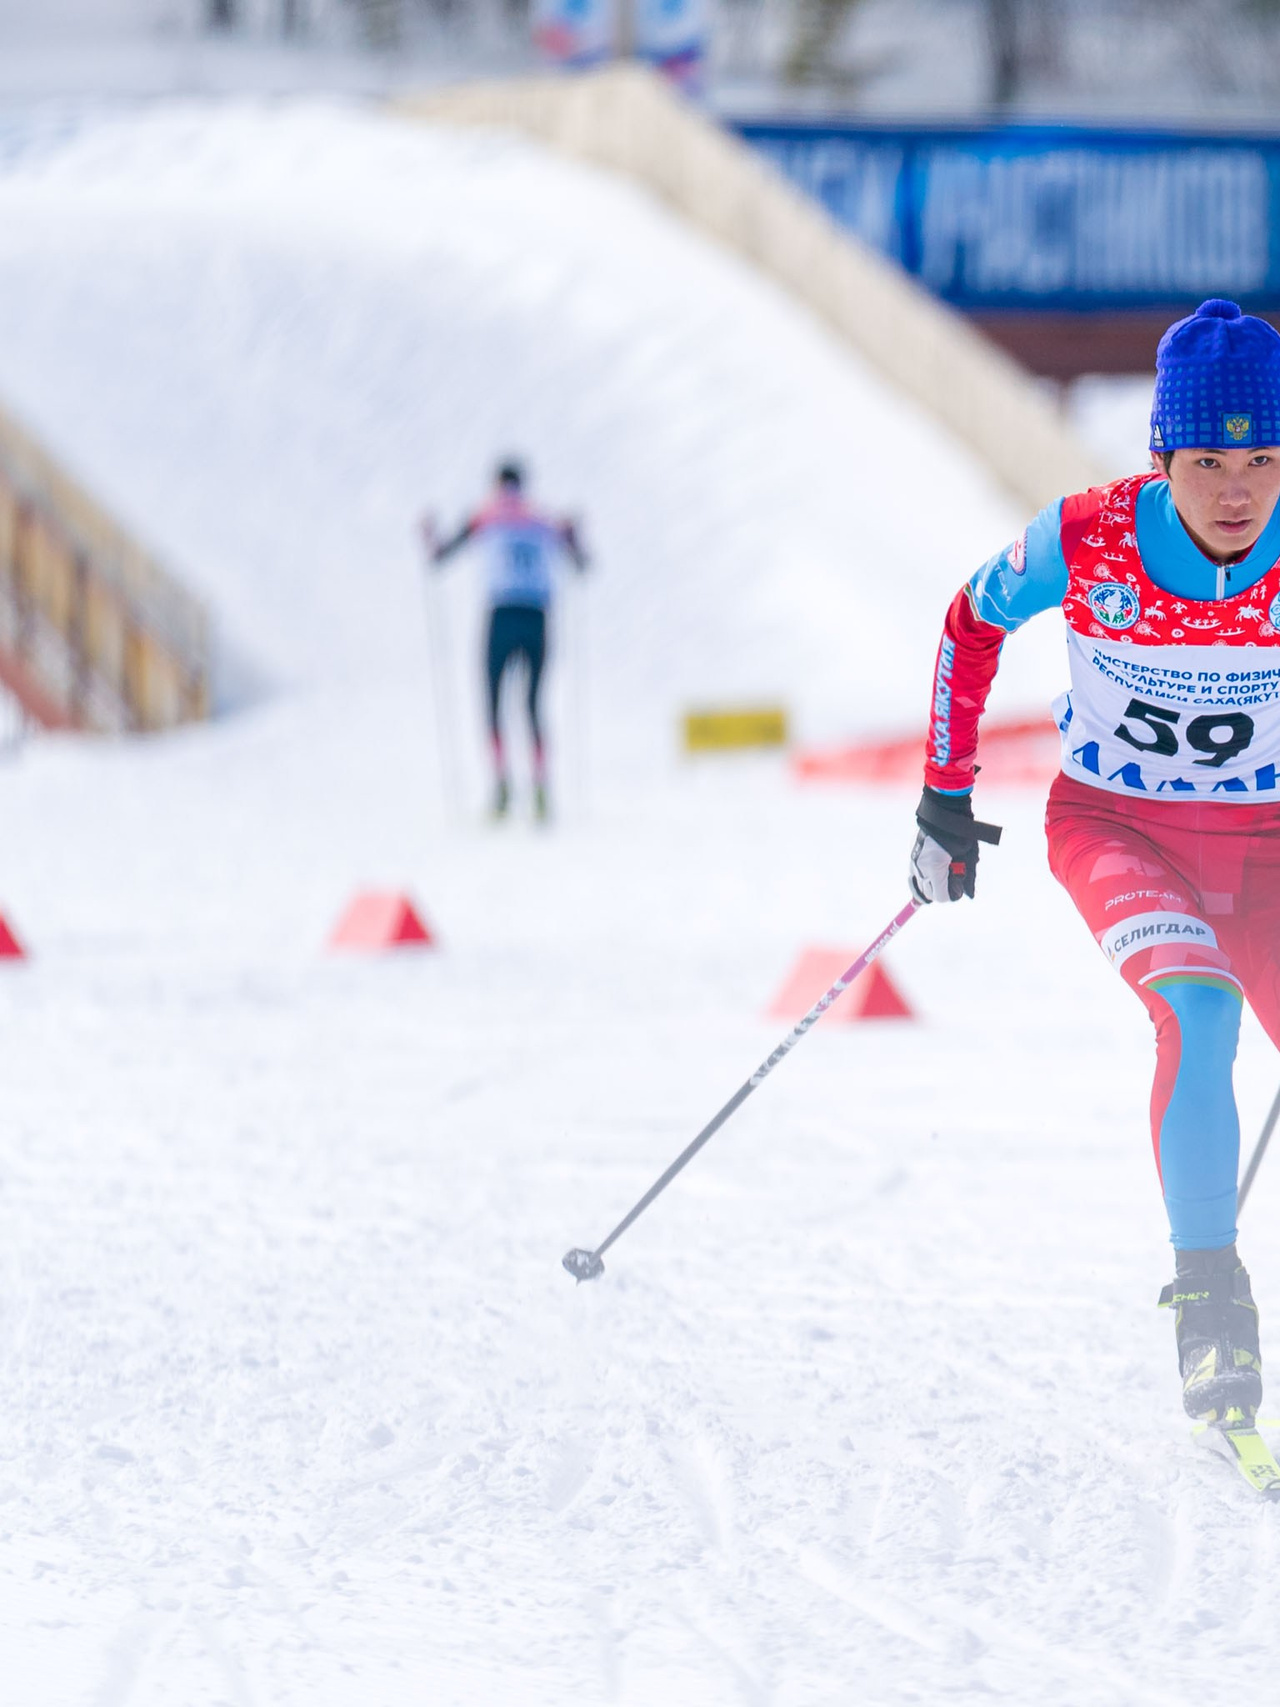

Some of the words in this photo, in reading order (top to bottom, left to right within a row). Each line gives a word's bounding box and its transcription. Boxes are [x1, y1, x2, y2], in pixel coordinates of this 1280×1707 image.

[1121, 670, 1196, 694] УЛЬТУРЕ
[1201, 685, 1213, 695] И
[1217, 680, 1280, 695] СПОРТУ
[1197, 671, 1221, 683] ПО
[1114, 698, 1255, 768] 59
[1114, 923, 1206, 953] СЕЛИГДАР
